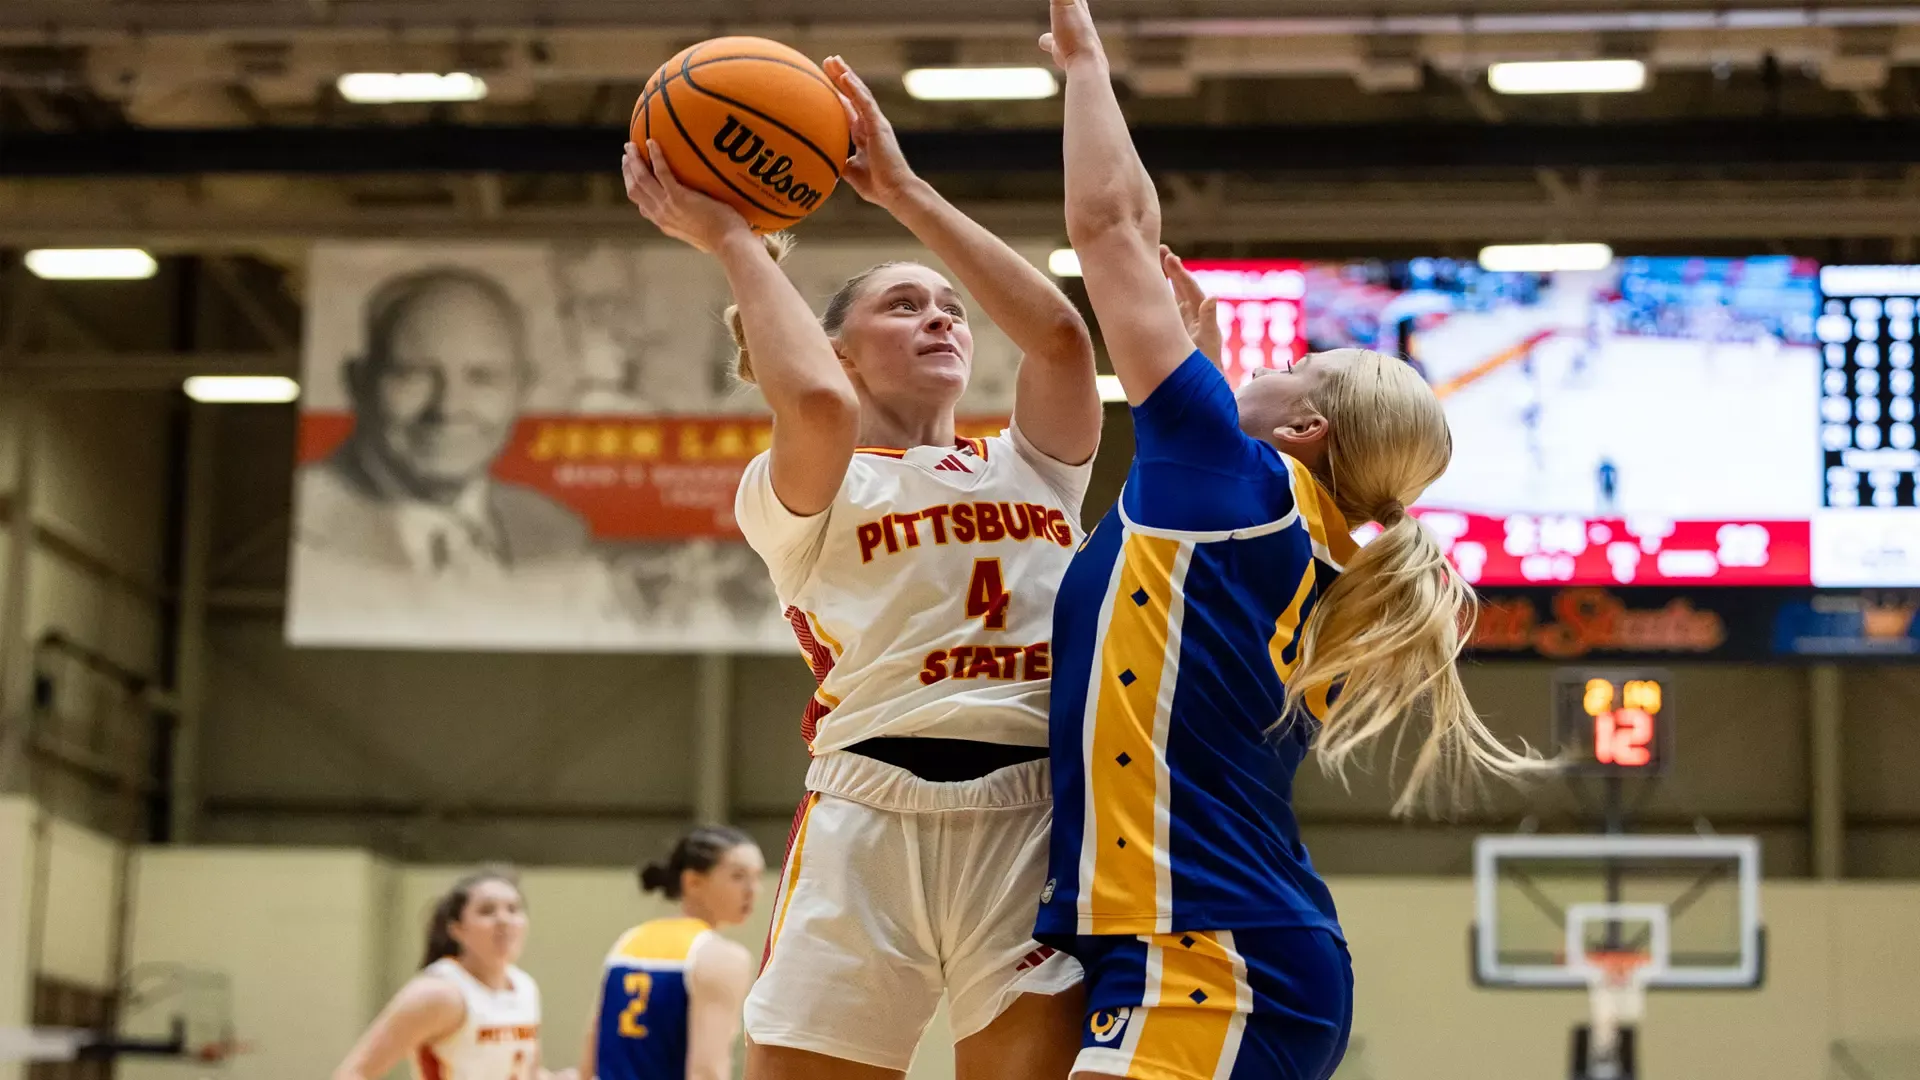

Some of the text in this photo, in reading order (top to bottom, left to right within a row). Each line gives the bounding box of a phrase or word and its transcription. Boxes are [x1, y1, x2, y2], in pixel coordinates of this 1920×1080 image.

[713, 113, 822, 211] Wilson
[856, 502, 1073, 564] PITTSBURG
[964, 556, 1011, 632] 4
[919, 642, 1052, 686] STATE
[1595, 707, 1654, 767] 12
[617, 972, 653, 1039] 2
